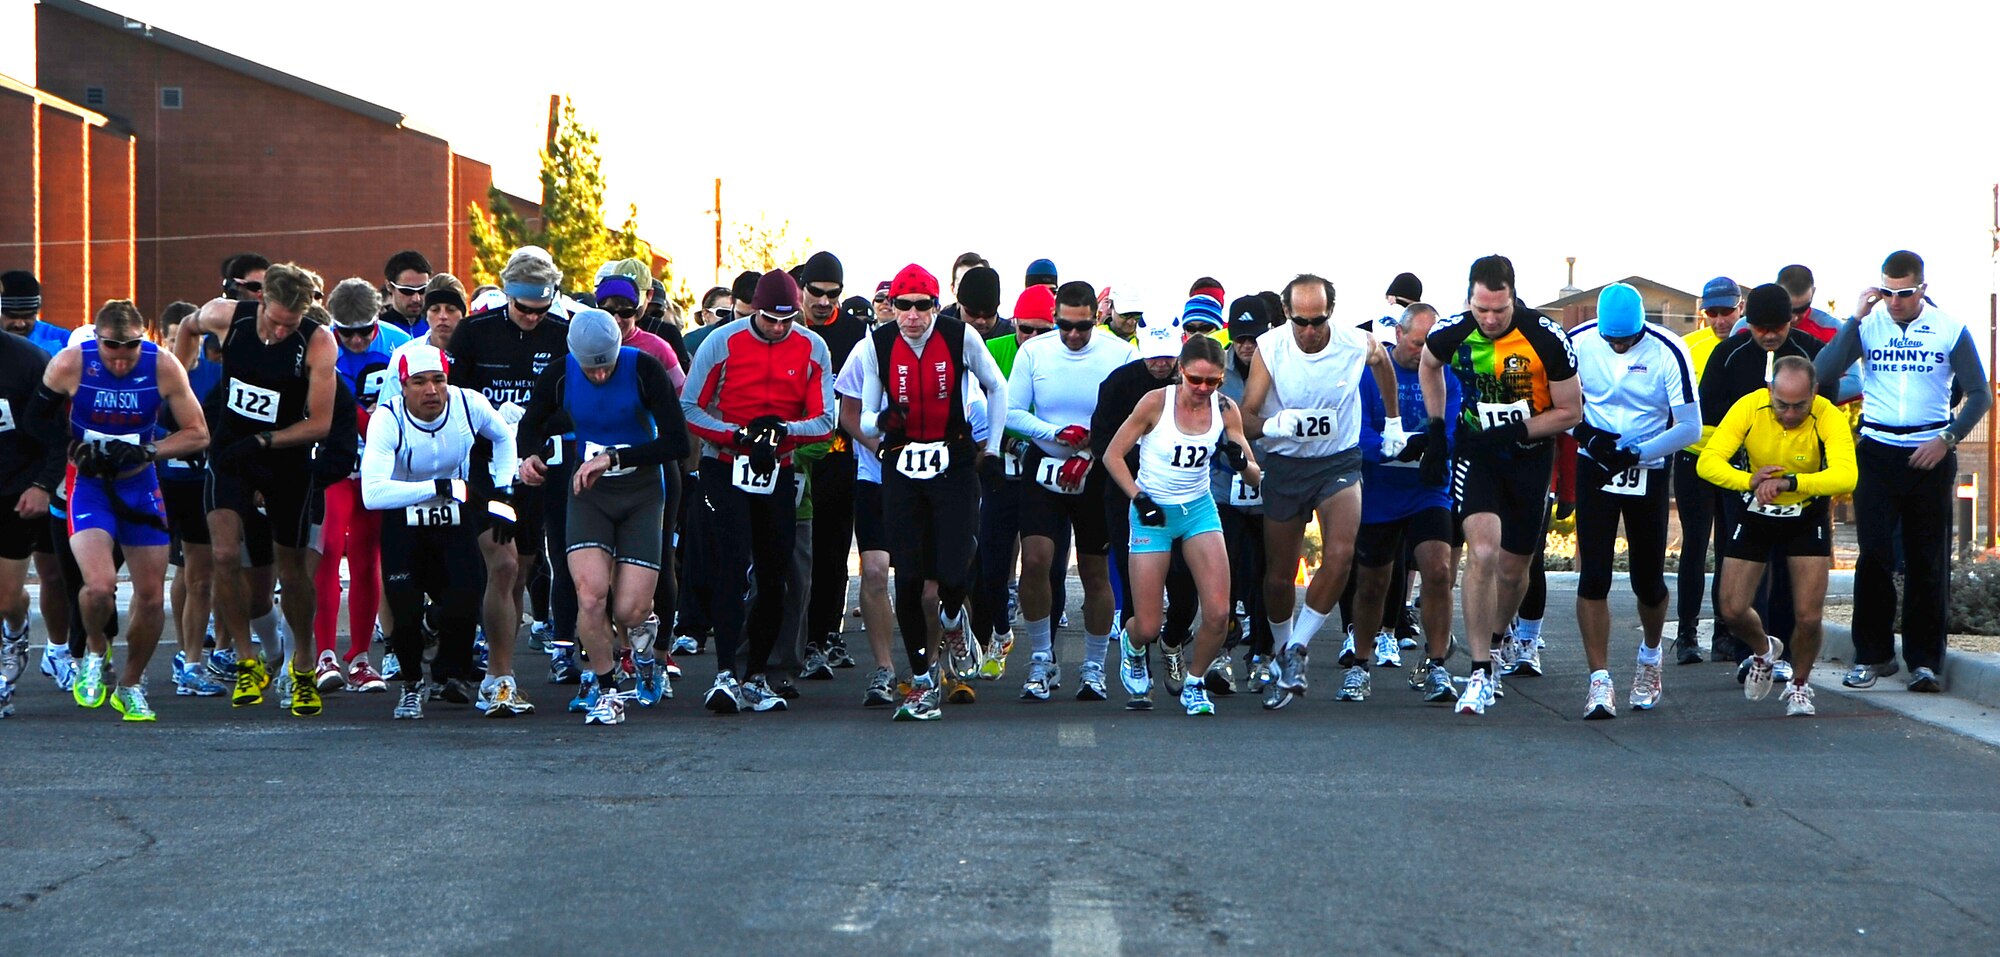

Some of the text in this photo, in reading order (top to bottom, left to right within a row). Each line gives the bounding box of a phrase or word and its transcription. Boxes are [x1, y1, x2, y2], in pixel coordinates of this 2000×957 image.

[1867, 349, 1944, 363] JOHNNY'S
[1872, 364, 1933, 373] BIKE SHOP
[235, 388, 271, 416] 122
[482, 387, 531, 403] OUTLA
[1295, 416, 1331, 437] 126
[904, 449, 941, 472] 114
[1171, 445, 1208, 468] 132
[1606, 468, 1640, 488] 39
[415, 505, 452, 525] 169
